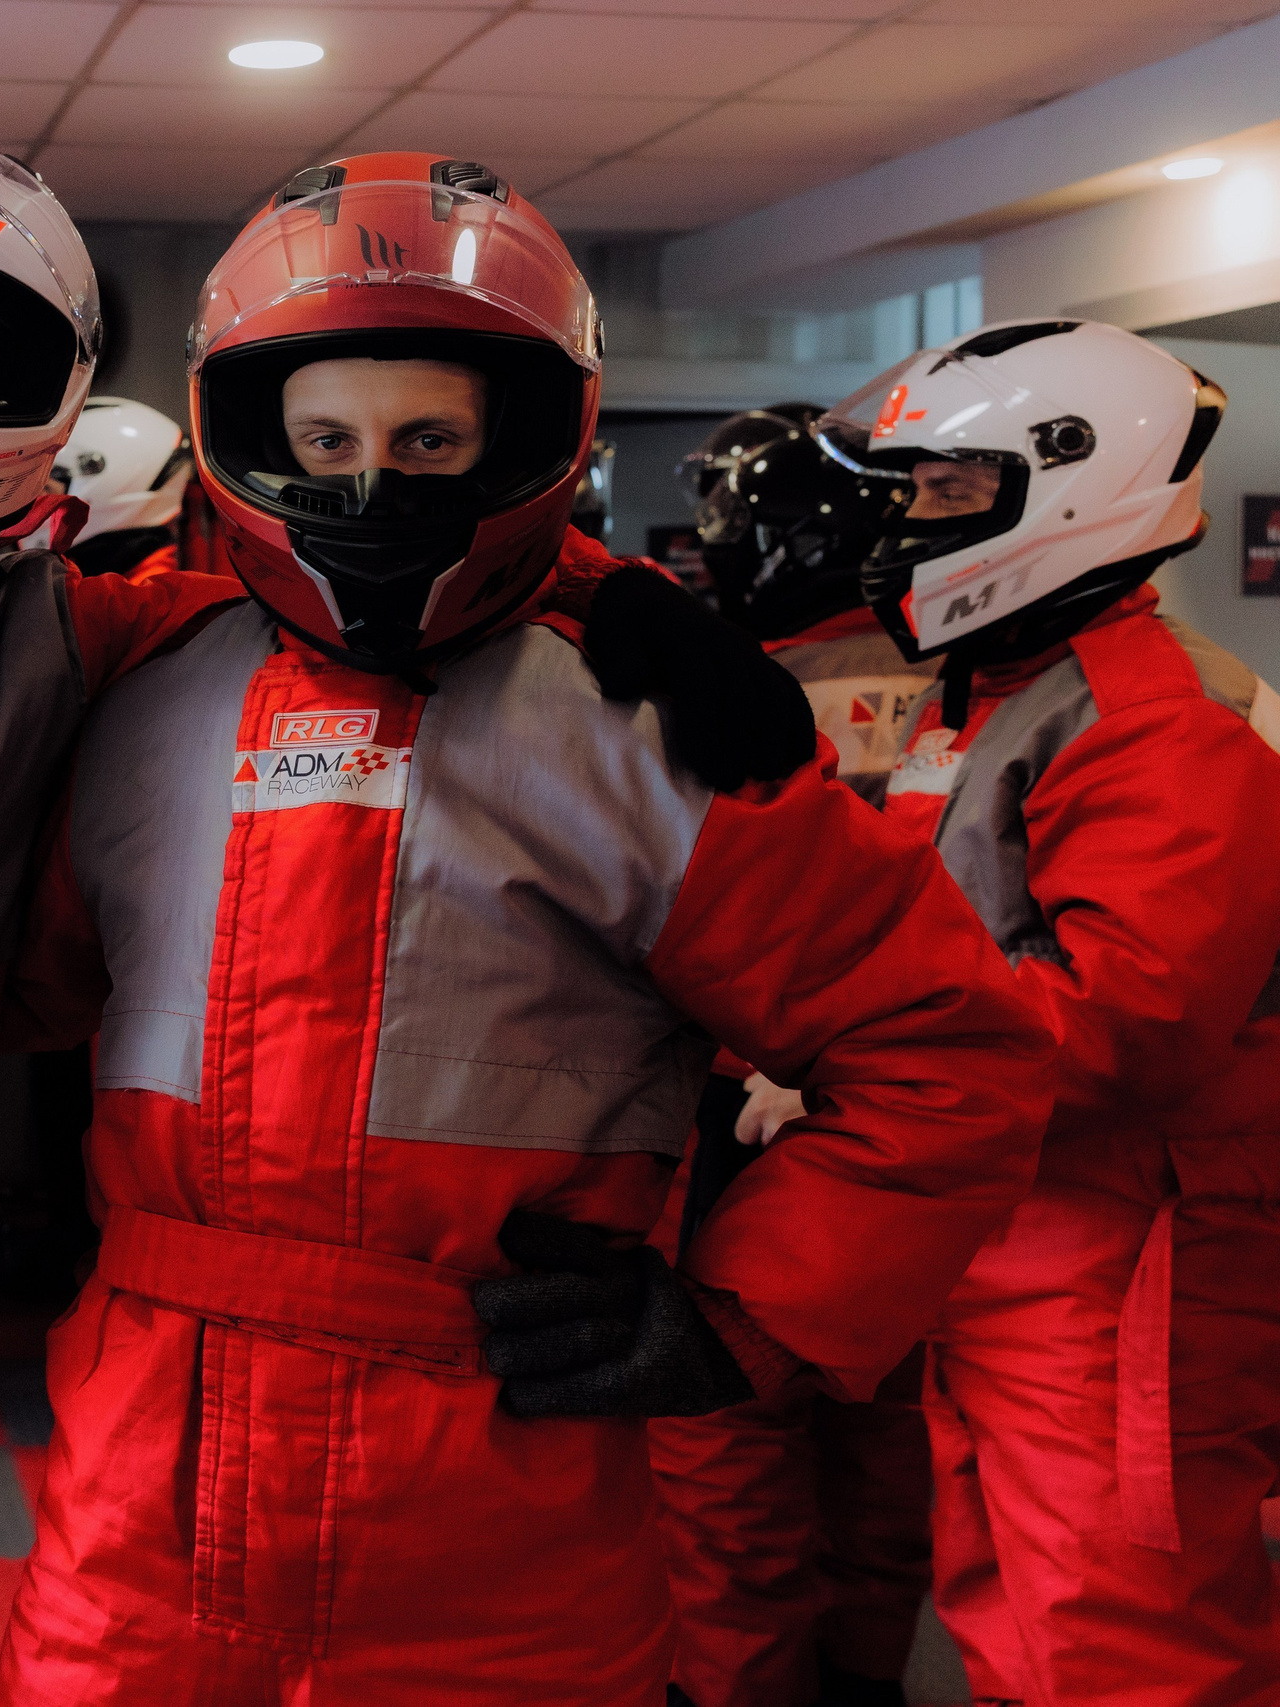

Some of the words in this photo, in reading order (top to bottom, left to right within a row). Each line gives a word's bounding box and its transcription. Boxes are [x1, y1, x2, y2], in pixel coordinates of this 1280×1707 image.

[281, 717, 367, 740] RLG
[271, 752, 345, 778] ADM
[267, 774, 368, 796] RACEWAY
